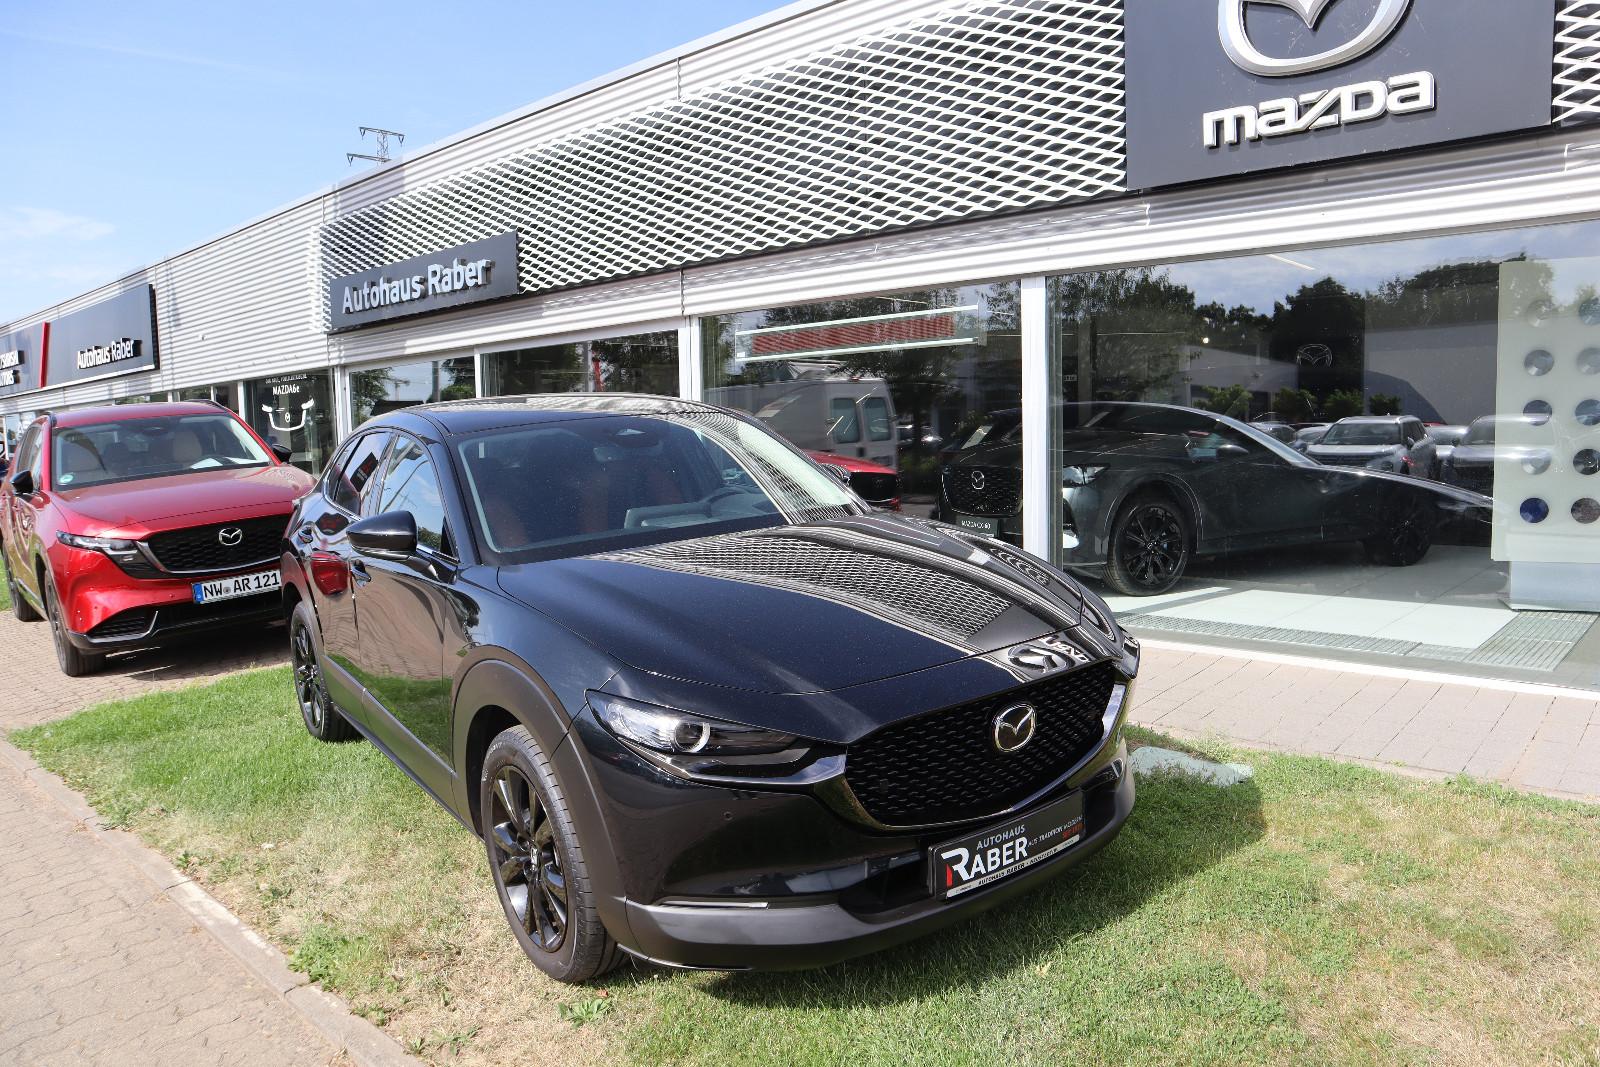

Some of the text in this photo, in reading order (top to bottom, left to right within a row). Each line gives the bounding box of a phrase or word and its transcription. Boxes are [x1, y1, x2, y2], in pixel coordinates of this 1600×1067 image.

[341, 257, 489, 314] Autohaus Raber
[77, 337, 135, 369] Autohaus Raber
[203, 572, 280, 599] NW AR 121
[976, 824, 1026, 851] AUTOHAUS
[941, 836, 1029, 888] RABER
